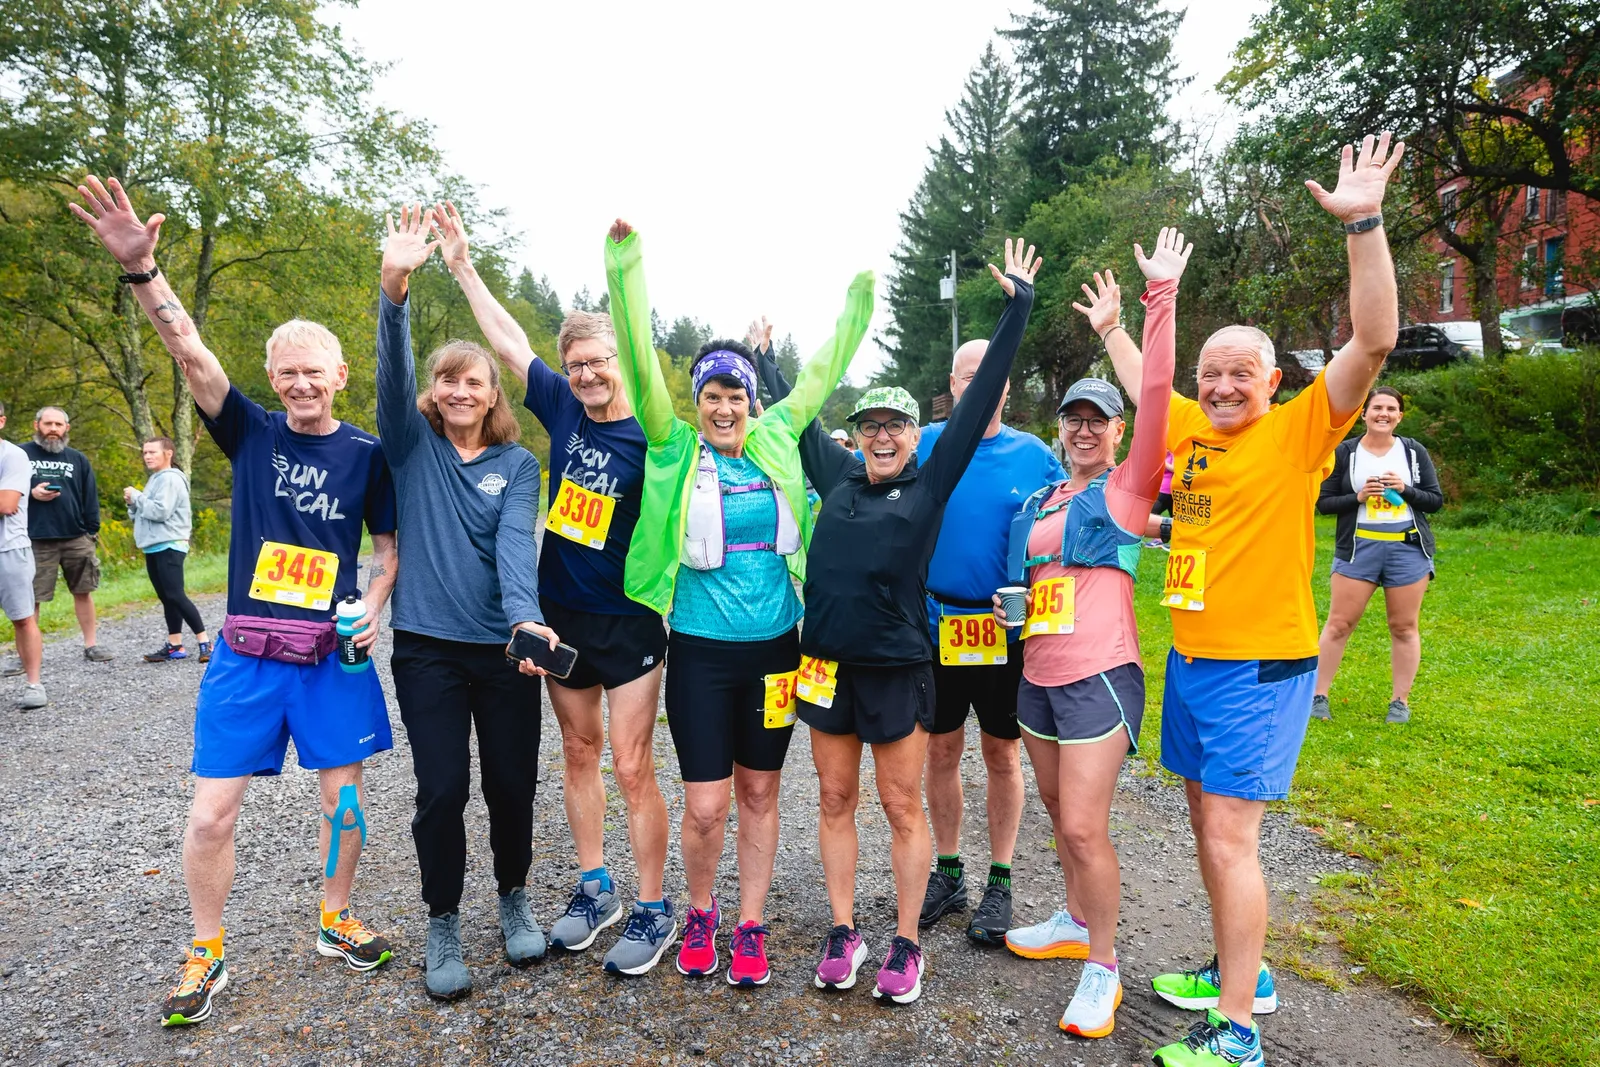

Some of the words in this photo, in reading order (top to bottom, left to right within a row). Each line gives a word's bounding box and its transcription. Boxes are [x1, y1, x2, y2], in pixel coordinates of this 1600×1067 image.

[560, 487, 604, 528] 330
[268, 549, 326, 588] 346
[1167, 555, 1195, 588] 332
[949, 618, 997, 648] 398
[800, 653, 831, 684] 26
